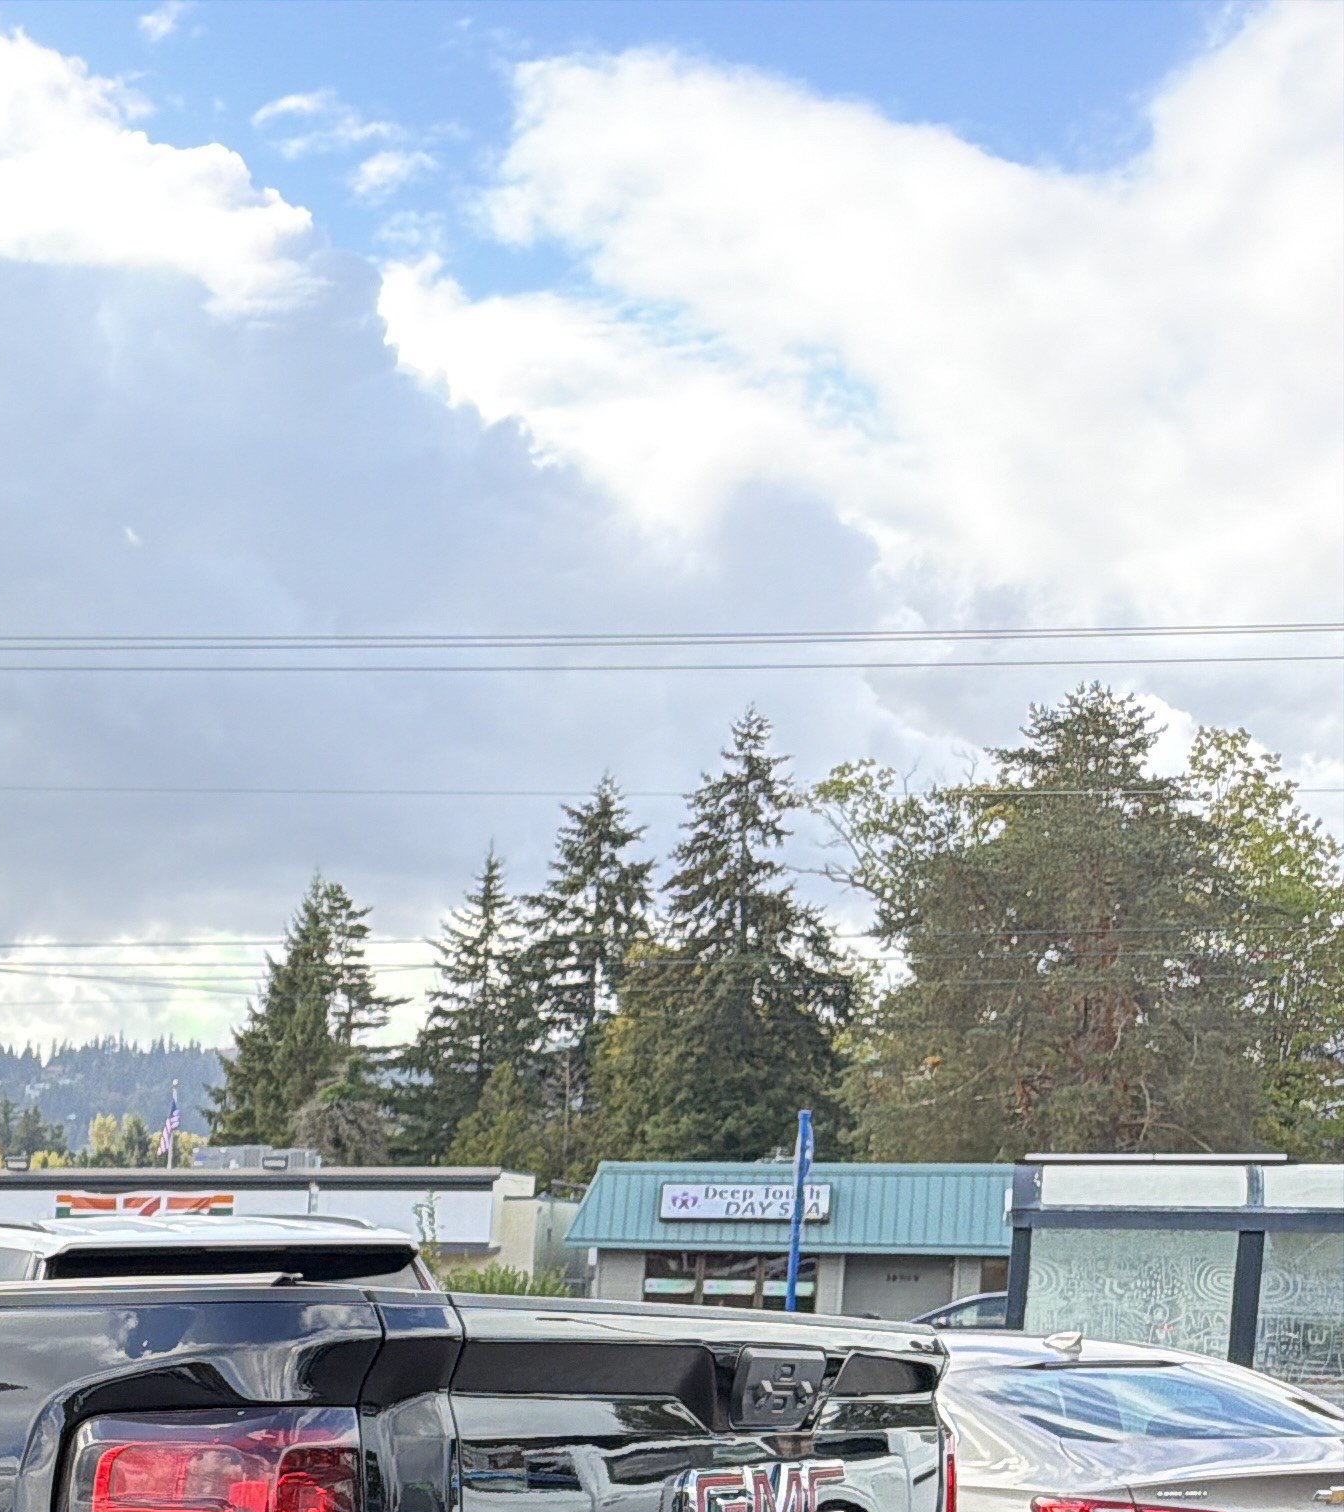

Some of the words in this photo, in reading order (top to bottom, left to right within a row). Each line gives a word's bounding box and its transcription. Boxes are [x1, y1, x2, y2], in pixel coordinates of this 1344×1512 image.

[704, 1186, 754, 1201] Deep
[764, 1186, 821, 1200] Touh
[725, 1202, 773, 1216] DAY
[778, 1202, 820, 1216] SA
